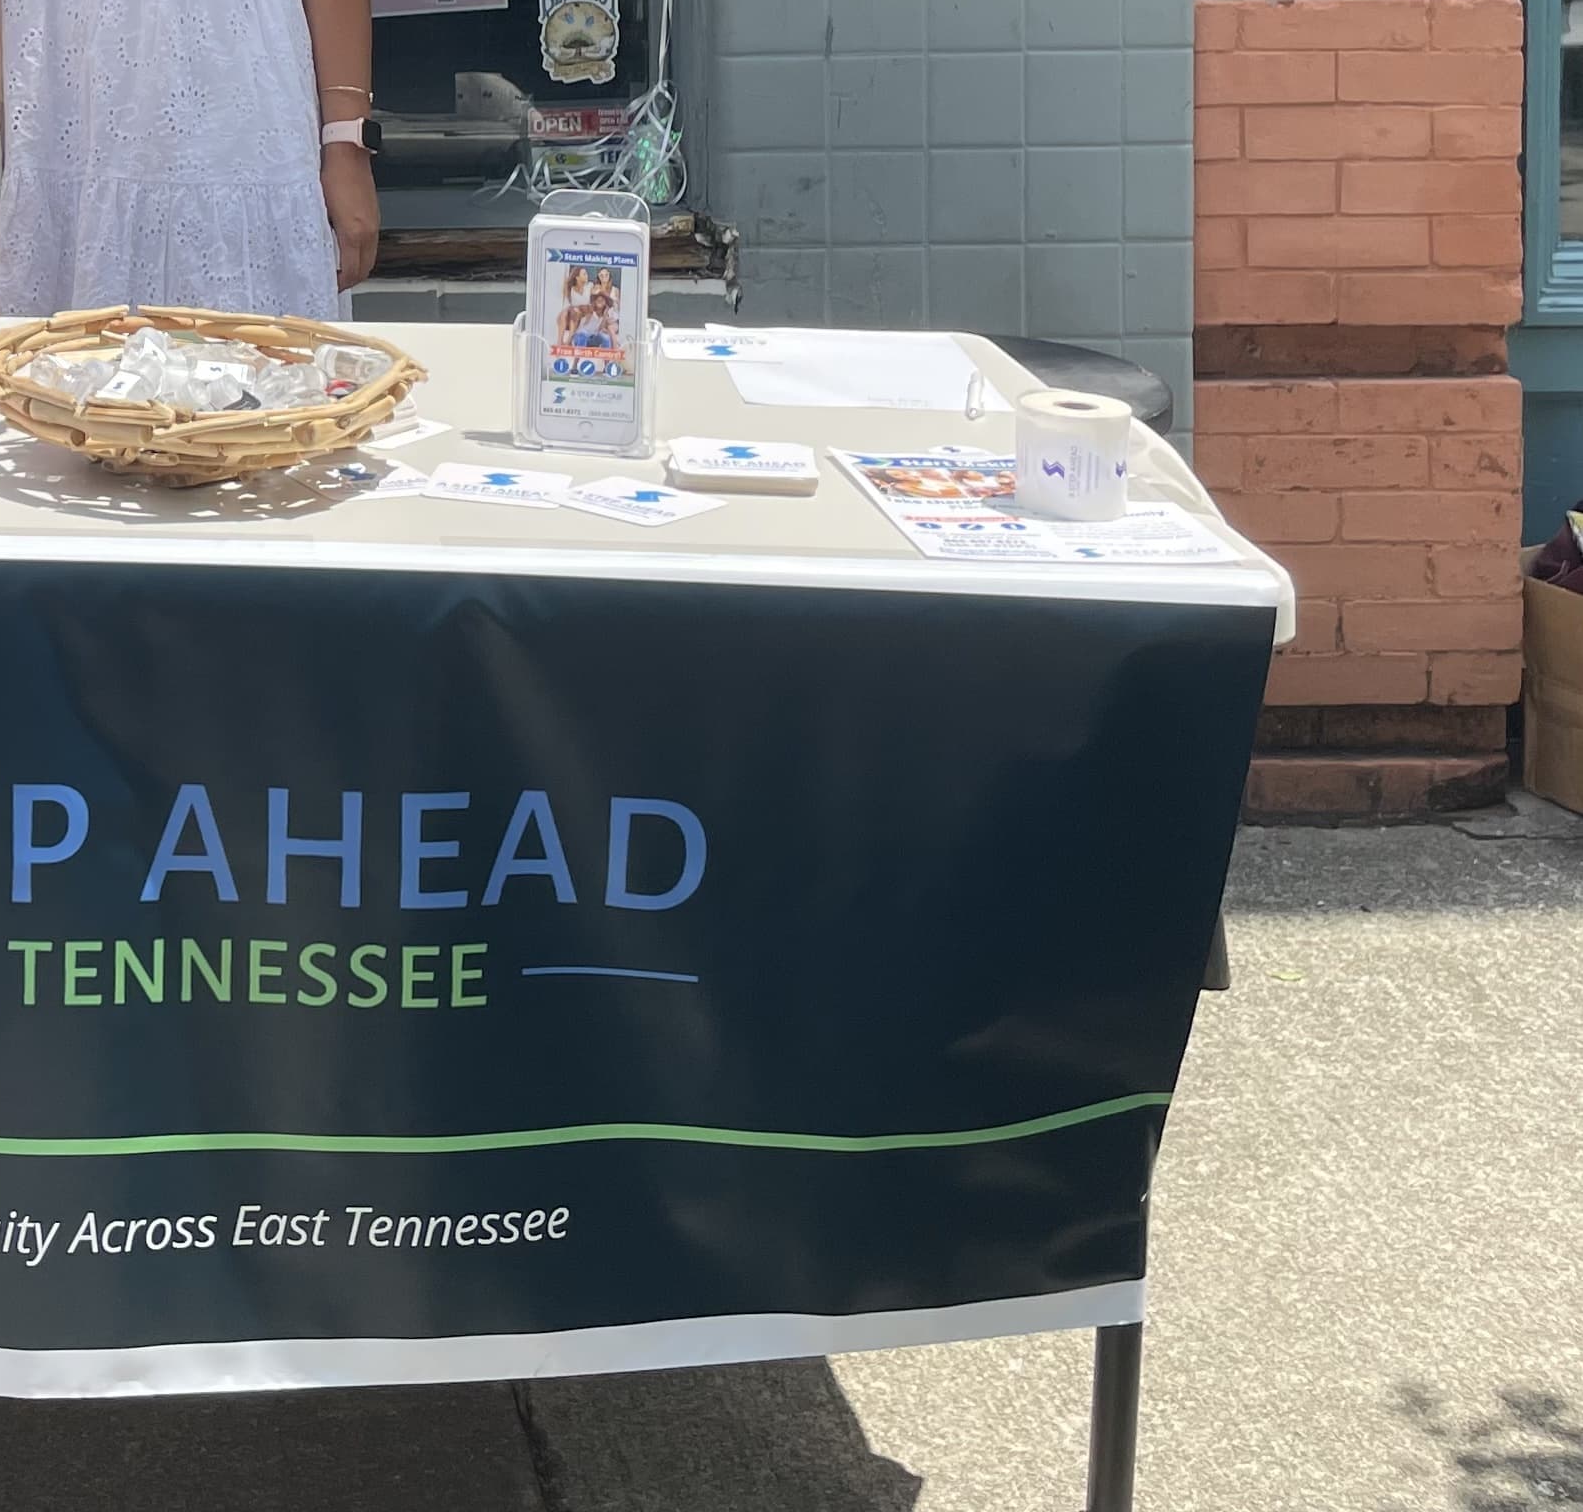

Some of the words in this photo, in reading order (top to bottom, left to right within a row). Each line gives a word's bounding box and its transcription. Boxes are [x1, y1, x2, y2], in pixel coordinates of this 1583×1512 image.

[533, 116, 582, 133] OPEN
[564, 253, 583, 262] Start
[585, 254, 612, 264] Making
[141, 785, 706, 910] AHEAD
[7, 940, 489, 1008] TENNESSEE
[69, 1208, 217, 1254] Across
[232, 1205, 331, 1246] East
[345, 1204, 569, 1250] Tennessee
